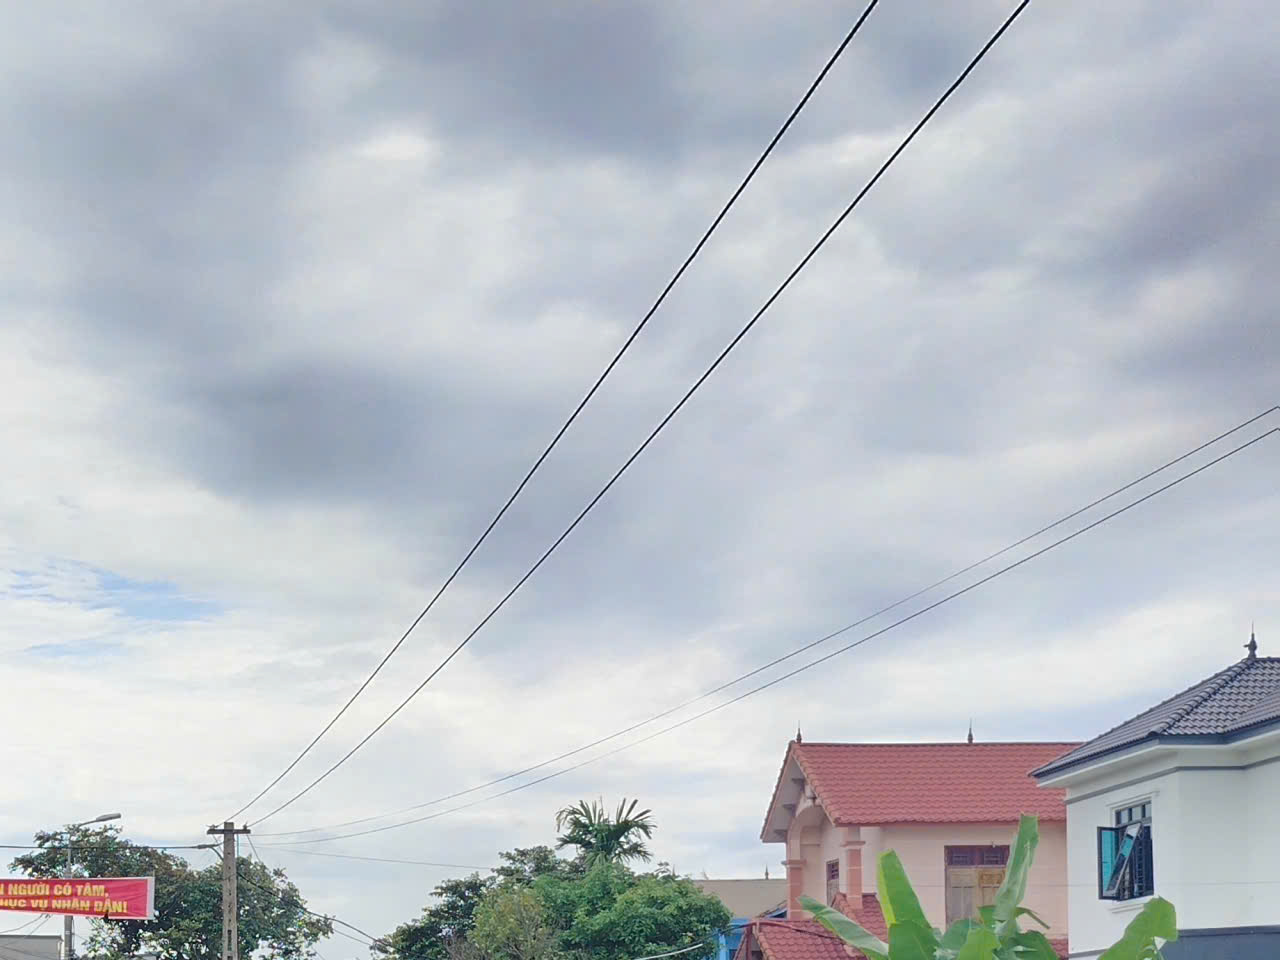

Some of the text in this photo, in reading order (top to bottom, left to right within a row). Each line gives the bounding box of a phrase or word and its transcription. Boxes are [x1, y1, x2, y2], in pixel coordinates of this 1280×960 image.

[8, 881, 50, 896] NGƯỜI
[54, 882, 72, 896] CÓ
[76, 882, 109, 898] TÂM,
[31, 899, 48, 911] VỤ
[51, 898, 90, 911] NHÂN
[94, 899, 128, 913] DÂN!
